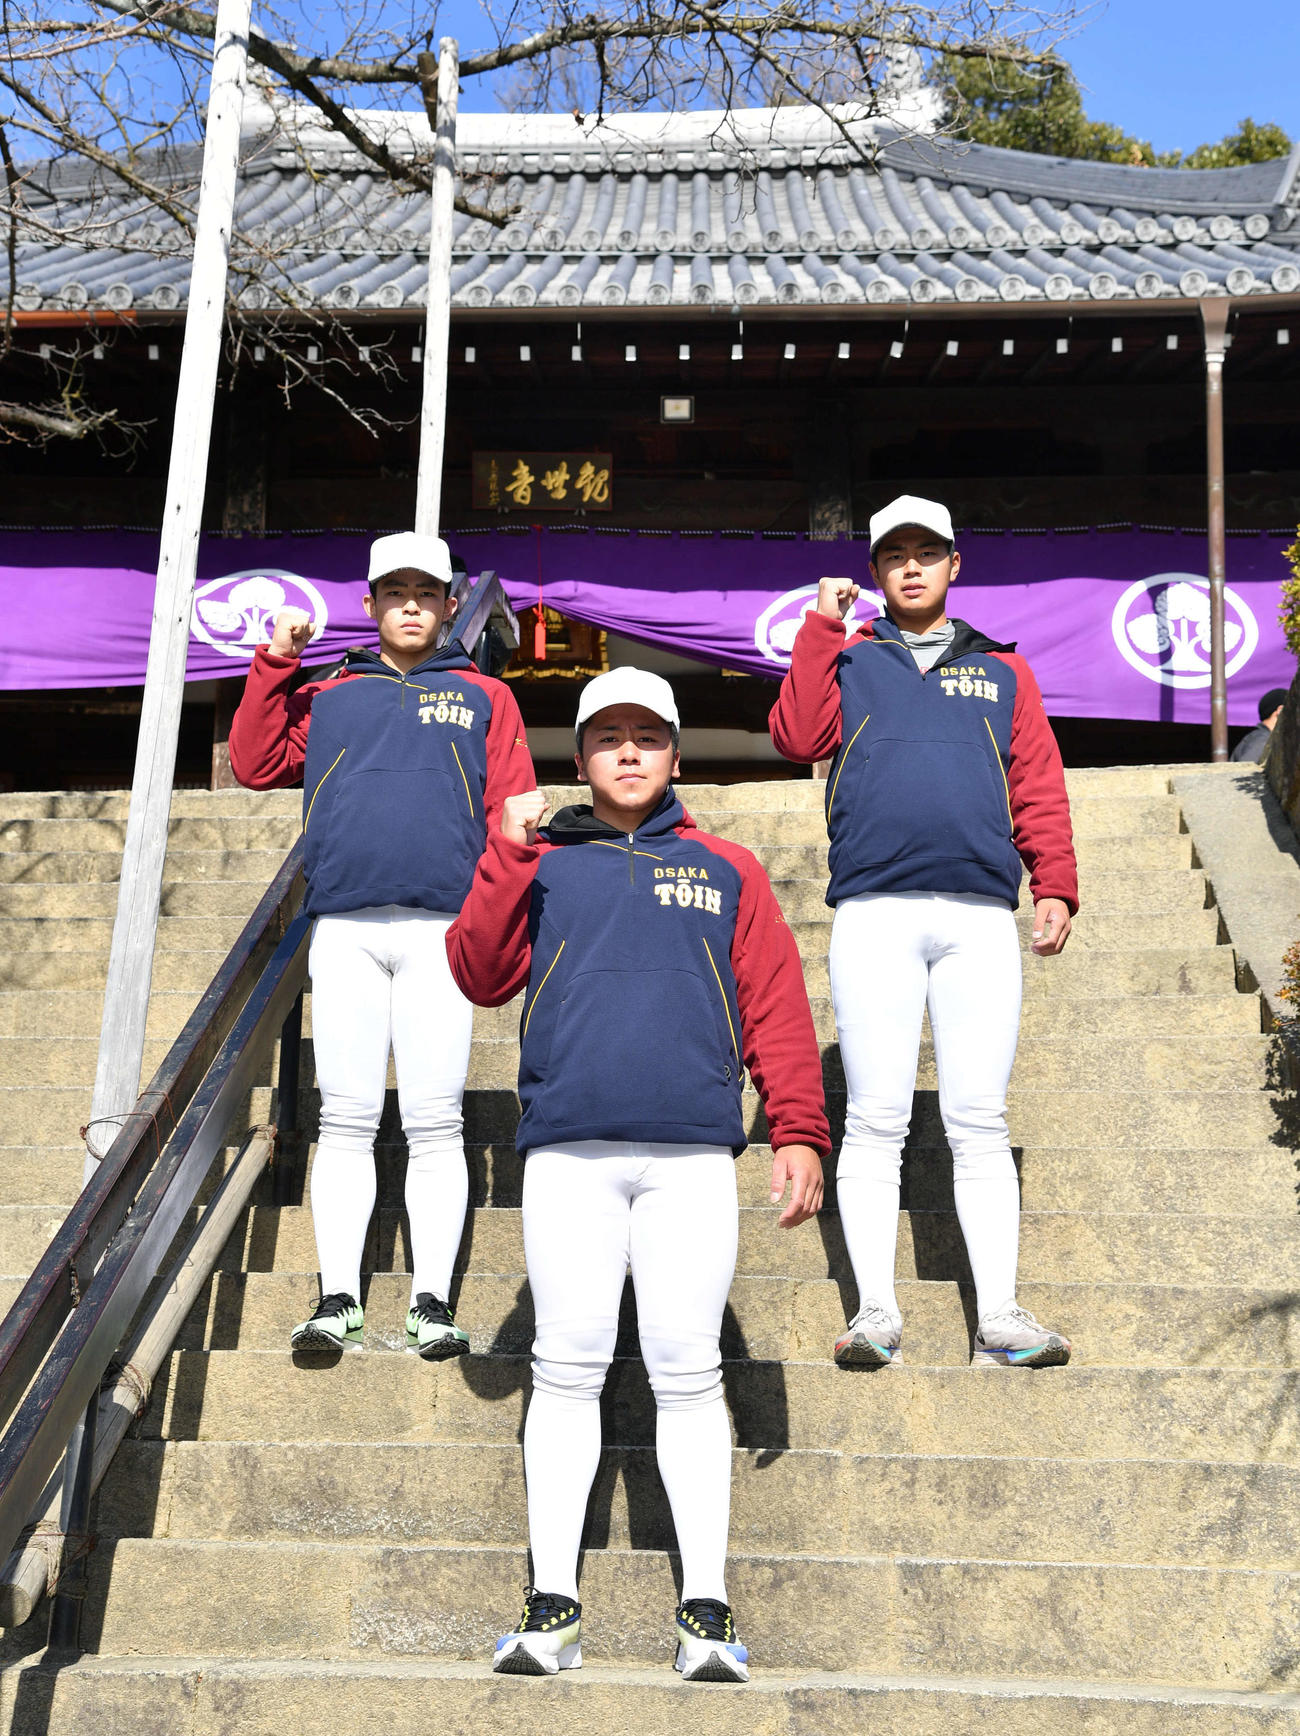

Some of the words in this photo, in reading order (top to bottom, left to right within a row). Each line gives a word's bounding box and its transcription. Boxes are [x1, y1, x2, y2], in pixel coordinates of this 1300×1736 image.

[940, 667, 986, 676] OSAKA
[419, 691, 464, 704] OSAKA
[654, 866, 709, 880] OSAKA
